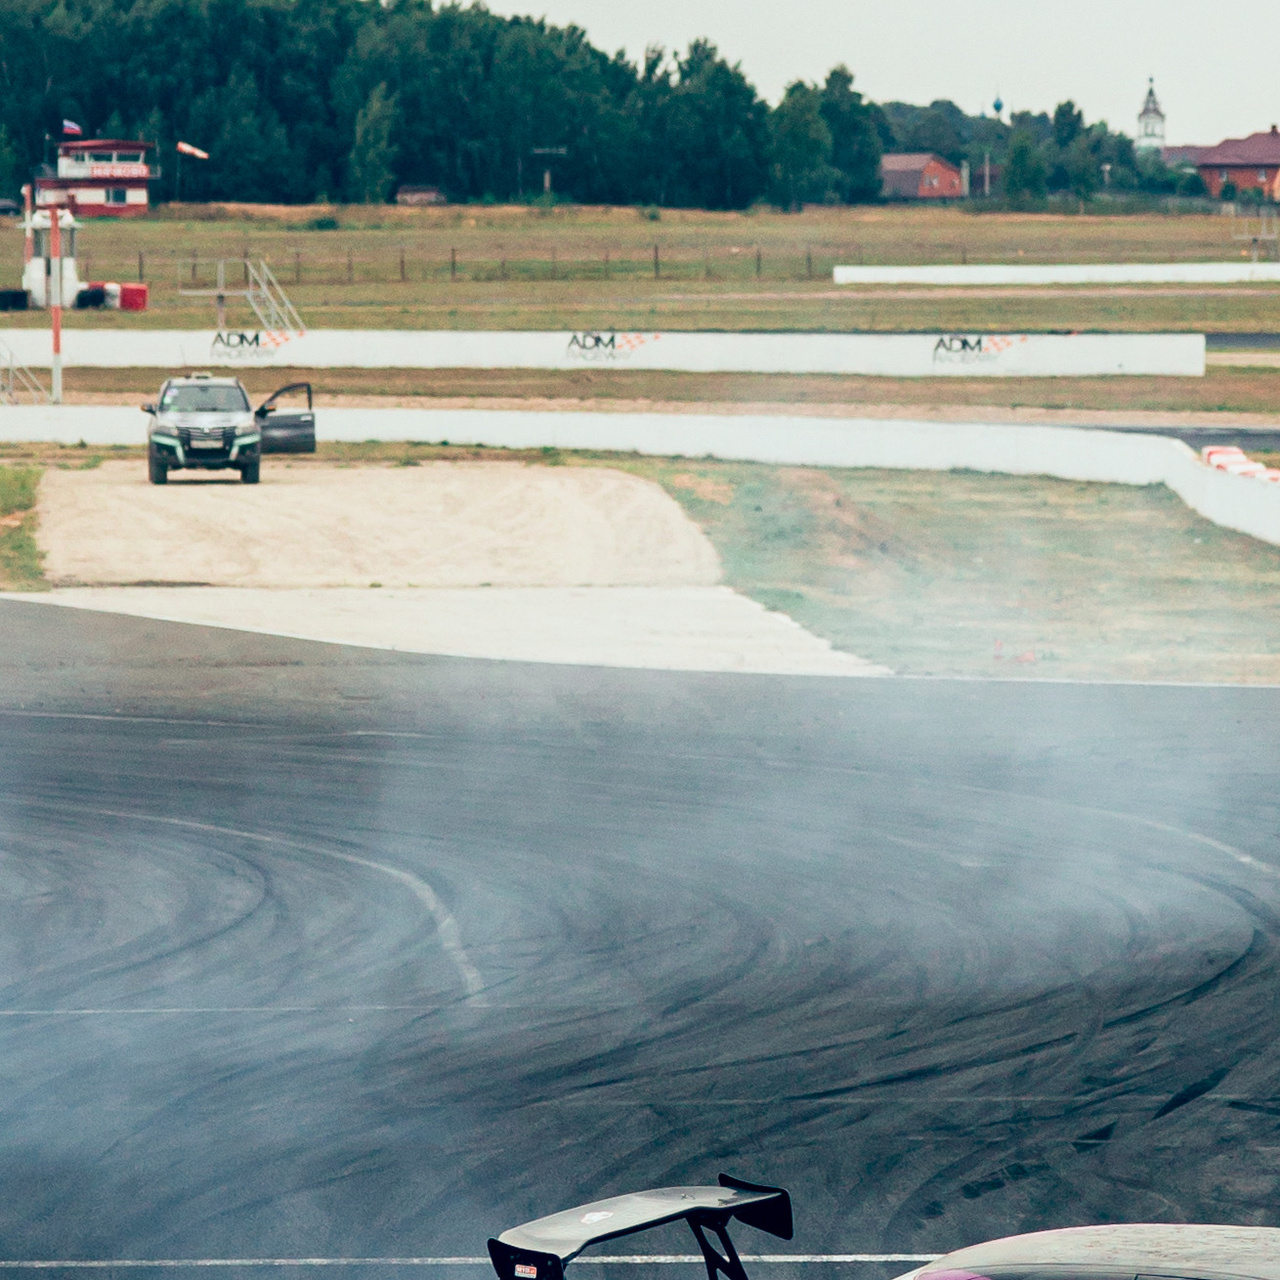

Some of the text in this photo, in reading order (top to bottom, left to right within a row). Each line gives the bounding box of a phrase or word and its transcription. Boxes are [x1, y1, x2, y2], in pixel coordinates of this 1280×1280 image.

[212, 331, 260, 348] ADM
[568, 333, 615, 350] ADM
[934, 336, 982, 353] ADM
